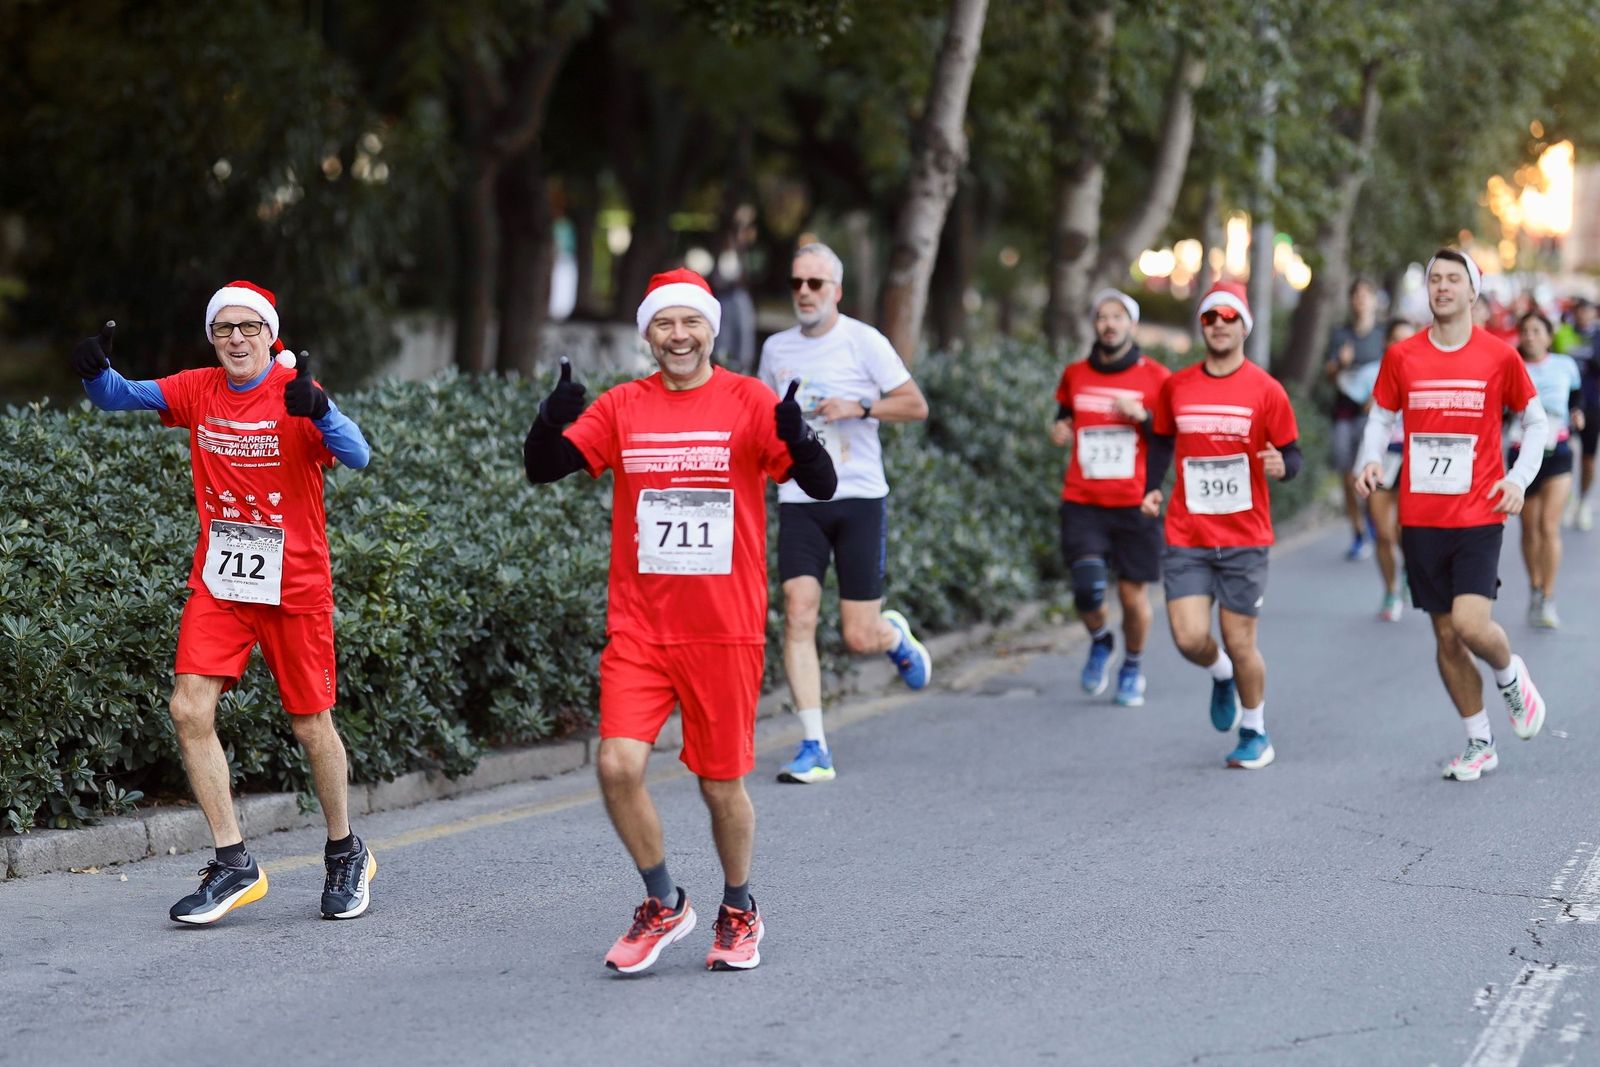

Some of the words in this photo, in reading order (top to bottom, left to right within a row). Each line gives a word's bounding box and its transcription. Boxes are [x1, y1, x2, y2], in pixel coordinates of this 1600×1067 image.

[238, 435, 279, 443] CARRERA
[240, 442, 279, 450] SILVESTRE
[646, 461, 680, 472] PALMA
[680, 461, 730, 472] PALMILLA
[1429, 456, 1452, 476] 77
[1199, 477, 1239, 498] 396
[656, 521, 714, 548] 711
[218, 550, 266, 580] 712
